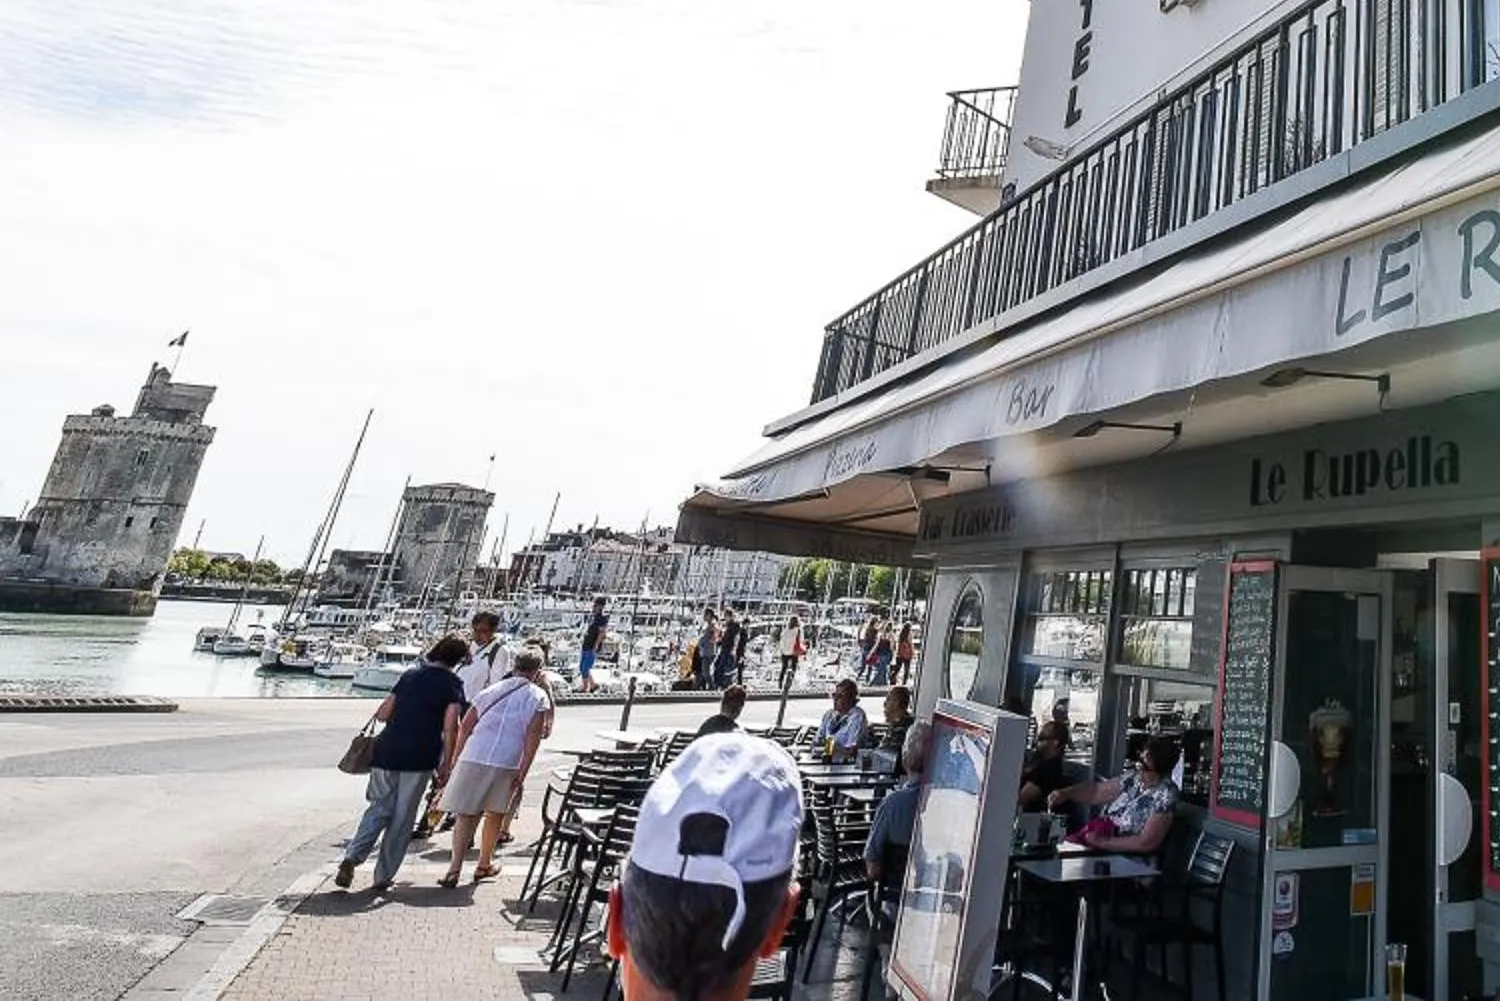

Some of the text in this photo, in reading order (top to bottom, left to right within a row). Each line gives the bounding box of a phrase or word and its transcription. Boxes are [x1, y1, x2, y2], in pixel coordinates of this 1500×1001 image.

[1335, 231, 1421, 336] LE
[1006, 380, 1055, 423] Bar
[1250, 436, 1460, 506] Le Rupella
